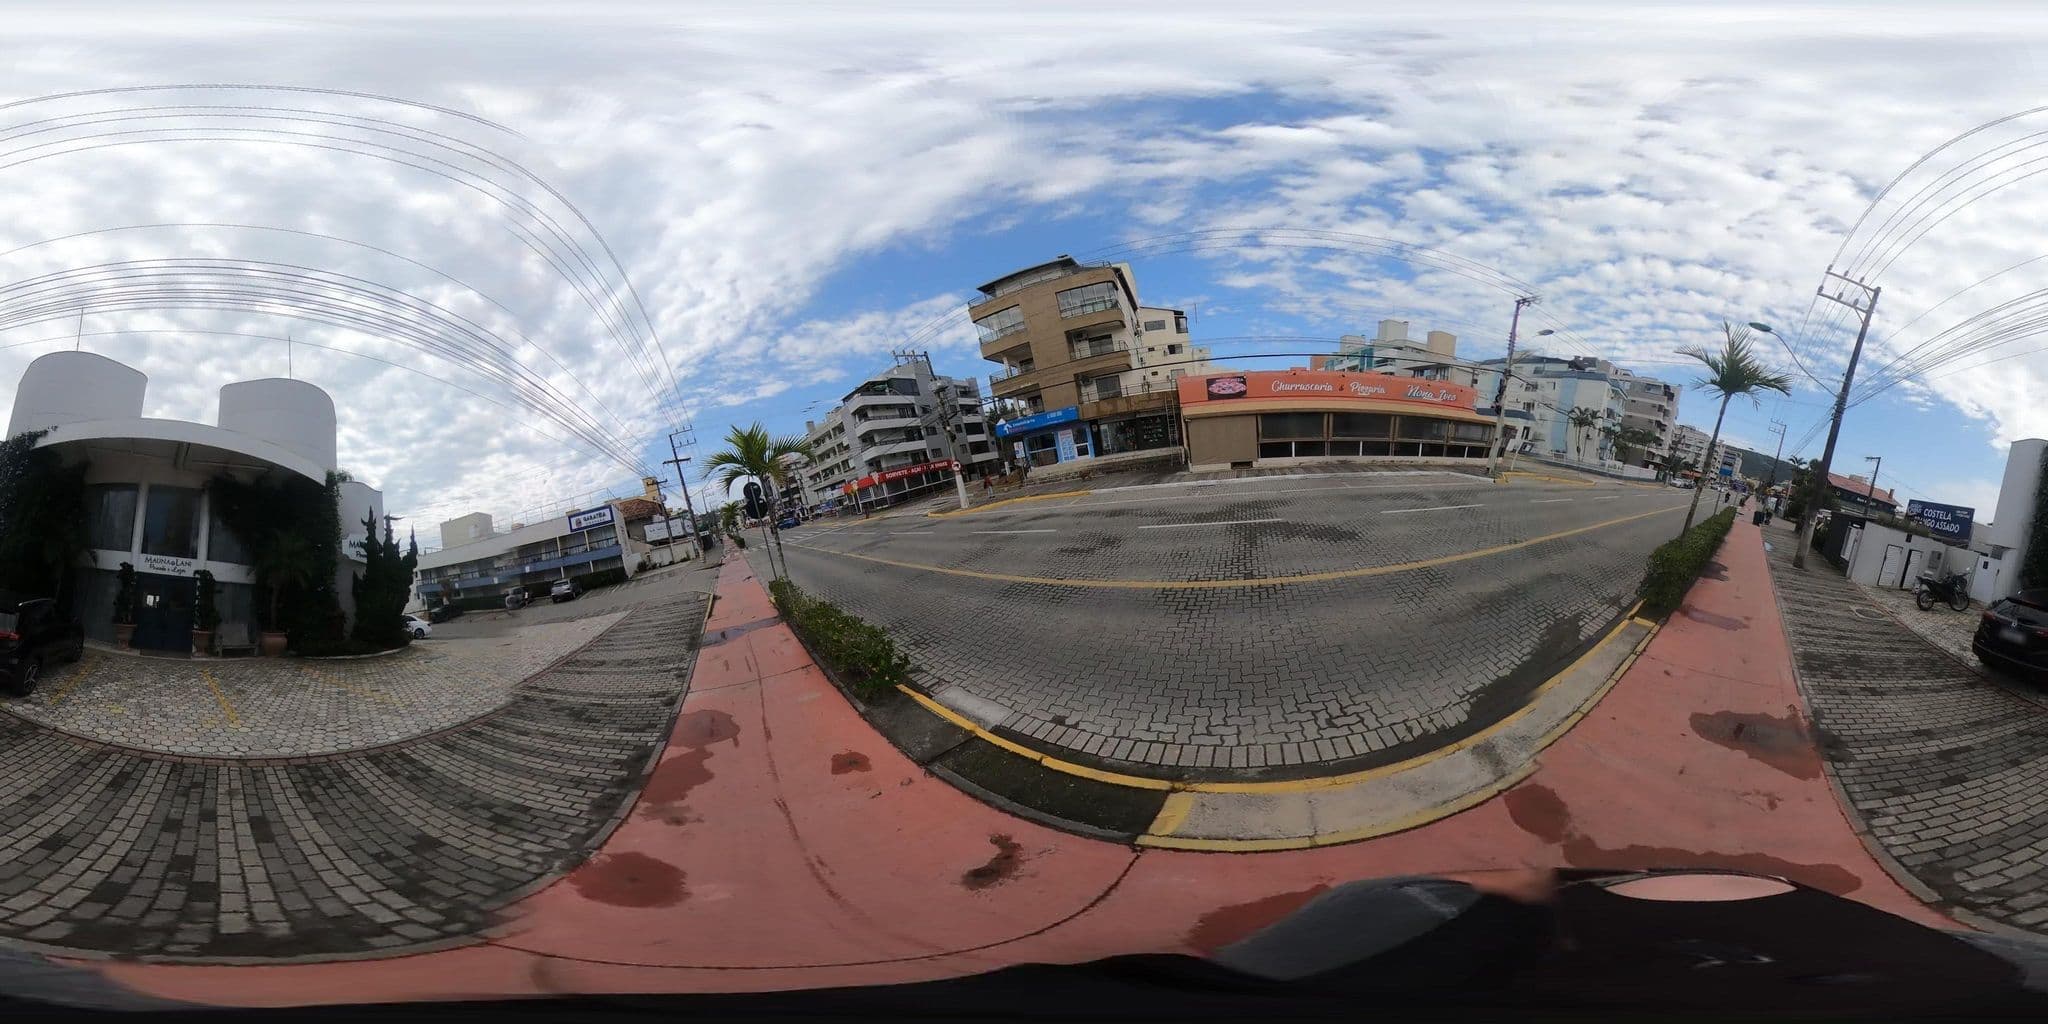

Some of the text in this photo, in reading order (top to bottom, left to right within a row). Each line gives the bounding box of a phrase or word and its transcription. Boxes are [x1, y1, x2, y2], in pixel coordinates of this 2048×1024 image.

[1271, 379, 1334, 393] Churrascaria
[1923, 508, 1952, 521] COSTELA
[1935, 521, 1960, 534] ASSADO
